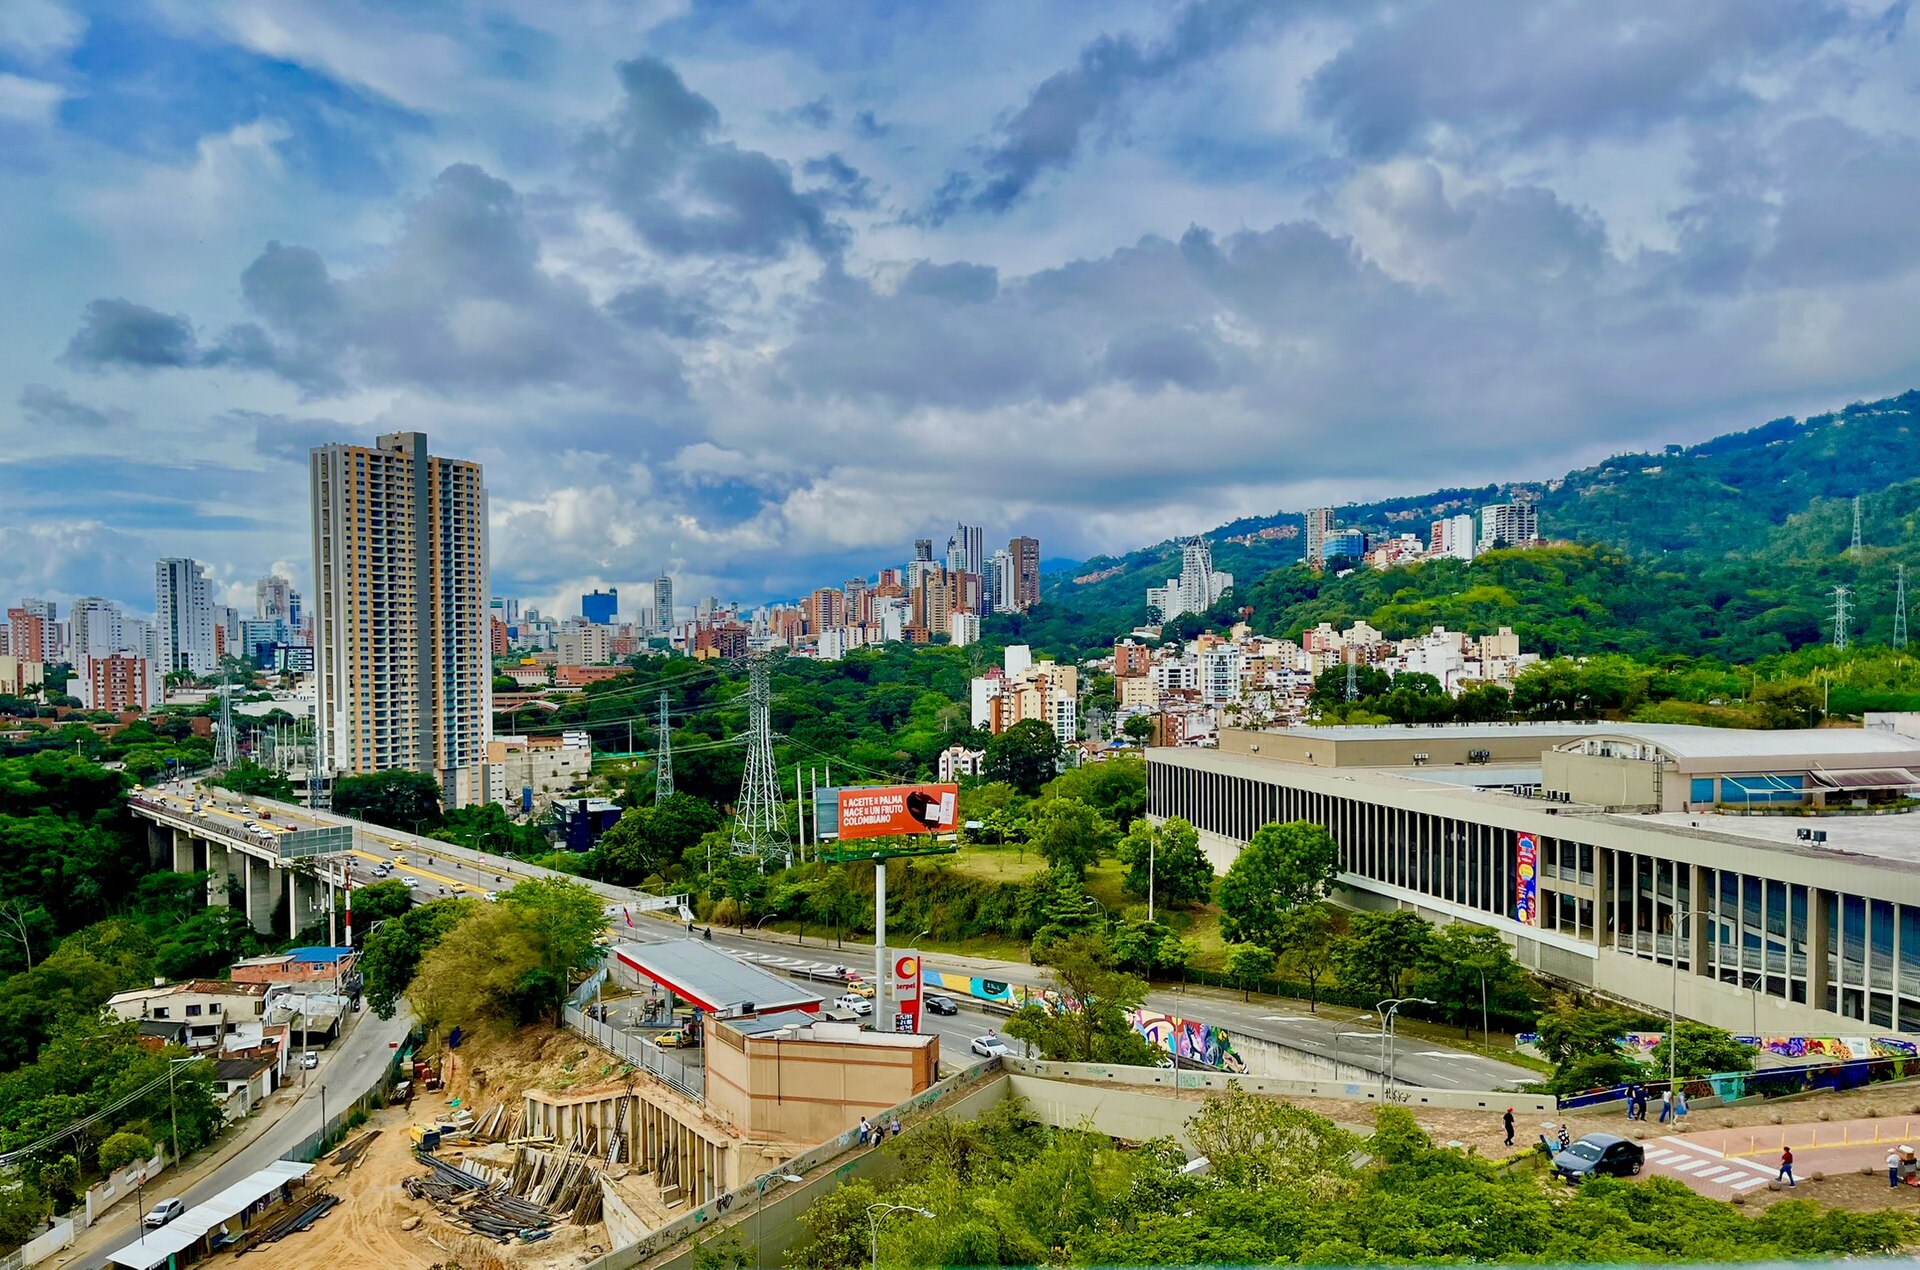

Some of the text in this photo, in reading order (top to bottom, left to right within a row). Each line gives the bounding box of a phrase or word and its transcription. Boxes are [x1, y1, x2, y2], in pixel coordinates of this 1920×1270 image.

[848, 797, 873, 807] ACEITE
[879, 795, 903, 804] PALMA
[843, 807, 863, 817] NACE
[869, 806, 880, 815] UN
[881, 804, 903, 814] FRUTO
[843, 814, 891, 826] COLOMBIANO
